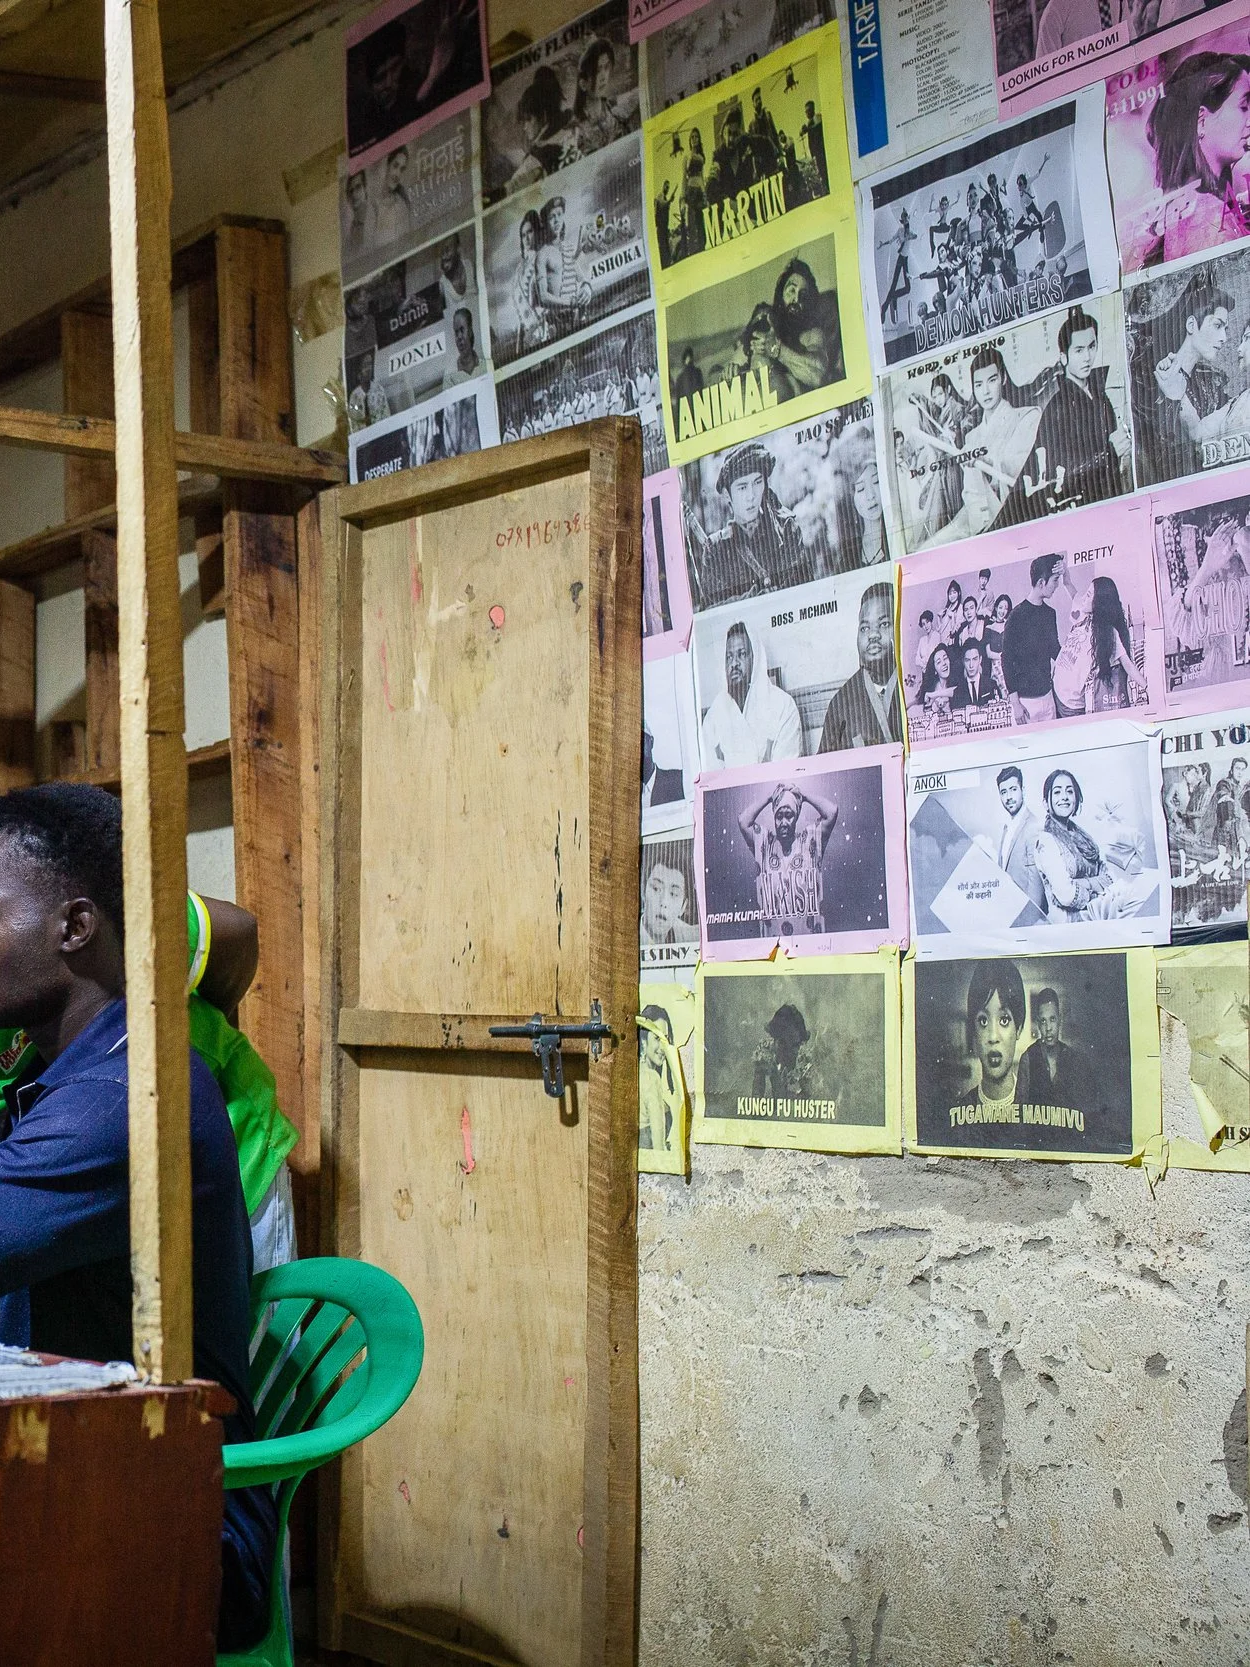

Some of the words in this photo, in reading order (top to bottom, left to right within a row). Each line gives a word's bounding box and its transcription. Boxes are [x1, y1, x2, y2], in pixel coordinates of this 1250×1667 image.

[1002, 61, 1049, 93] LOOKING
[1052, 50, 1075, 71] FOR
[1077, 31, 1120, 59] NAOMI
[702, 171, 786, 250] MARTIN
[590, 245, 642, 280] ASHOKA
[914, 303, 978, 353] DEMON
[978, 274, 1065, 327] HUNTERS
[389, 338, 444, 372] DONIA
[907, 361, 941, 380] WORD
[944, 353, 958, 365] OF
[678, 365, 778, 442] ANIMAL
[795, 424, 821, 445] TAO
[364, 457, 402, 480] DESPERATE
[1073, 544, 1115, 565] PRETTY
[1161, 732, 1203, 754] CHI
[913, 774, 947, 791] ANOKI
[706, 912, 734, 925] MAMA
[737, 1096, 774, 1117] KUNGU
[776, 1098, 791, 1118] FU
[793, 1099, 836, 1120] HUSTER
[949, 1102, 1020, 1128] TUGAWANE
[1022, 1104, 1085, 1132] MAUMIVU
